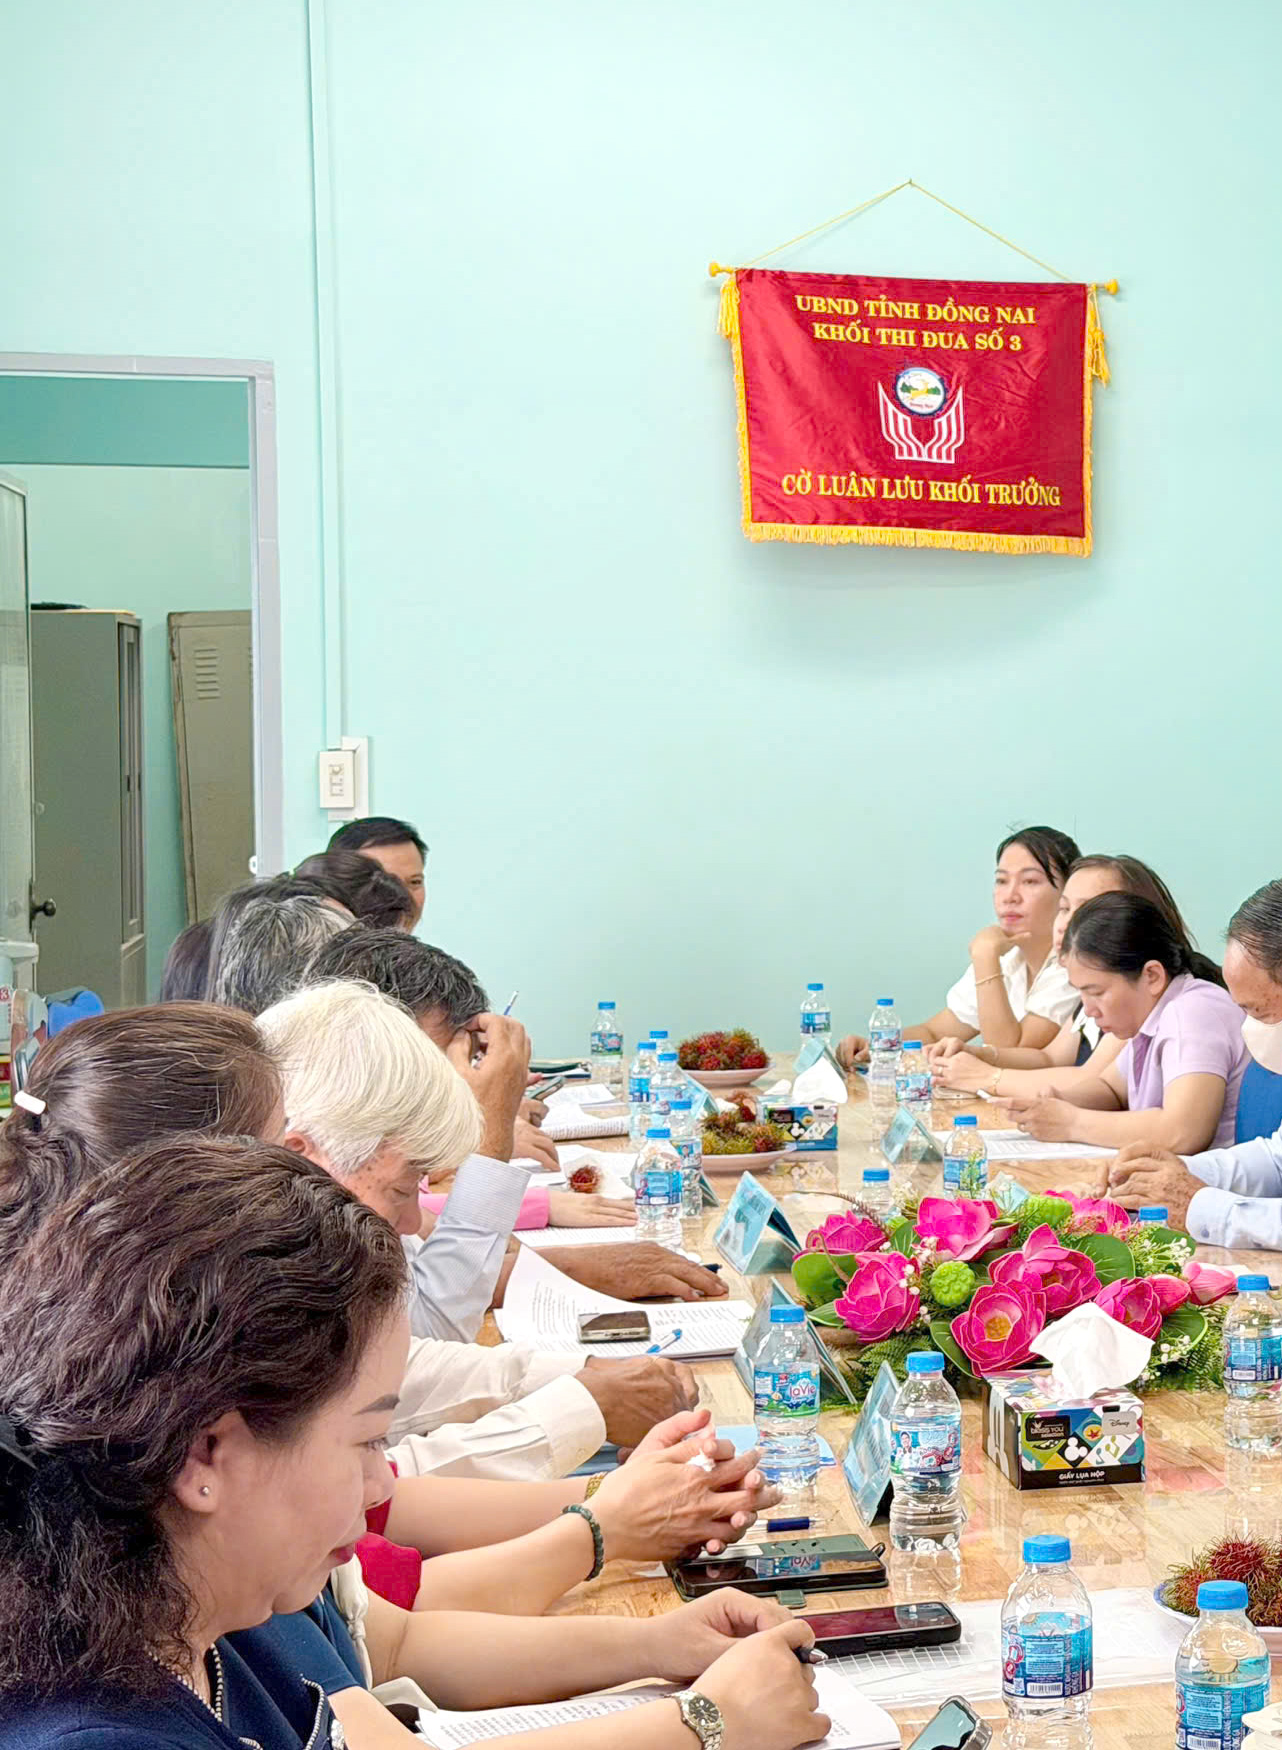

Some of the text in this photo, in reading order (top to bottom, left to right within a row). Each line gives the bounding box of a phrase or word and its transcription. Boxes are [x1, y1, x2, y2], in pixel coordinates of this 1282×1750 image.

[795, 294, 1036, 324] UBND TỈNH ĐỒNG NAI
[812, 319, 1022, 351] KHỐI THI ĐUA SỐ 3
[782, 468, 1060, 506] CỜ LUÂN LƯU KHỐI TRƯỞNG
